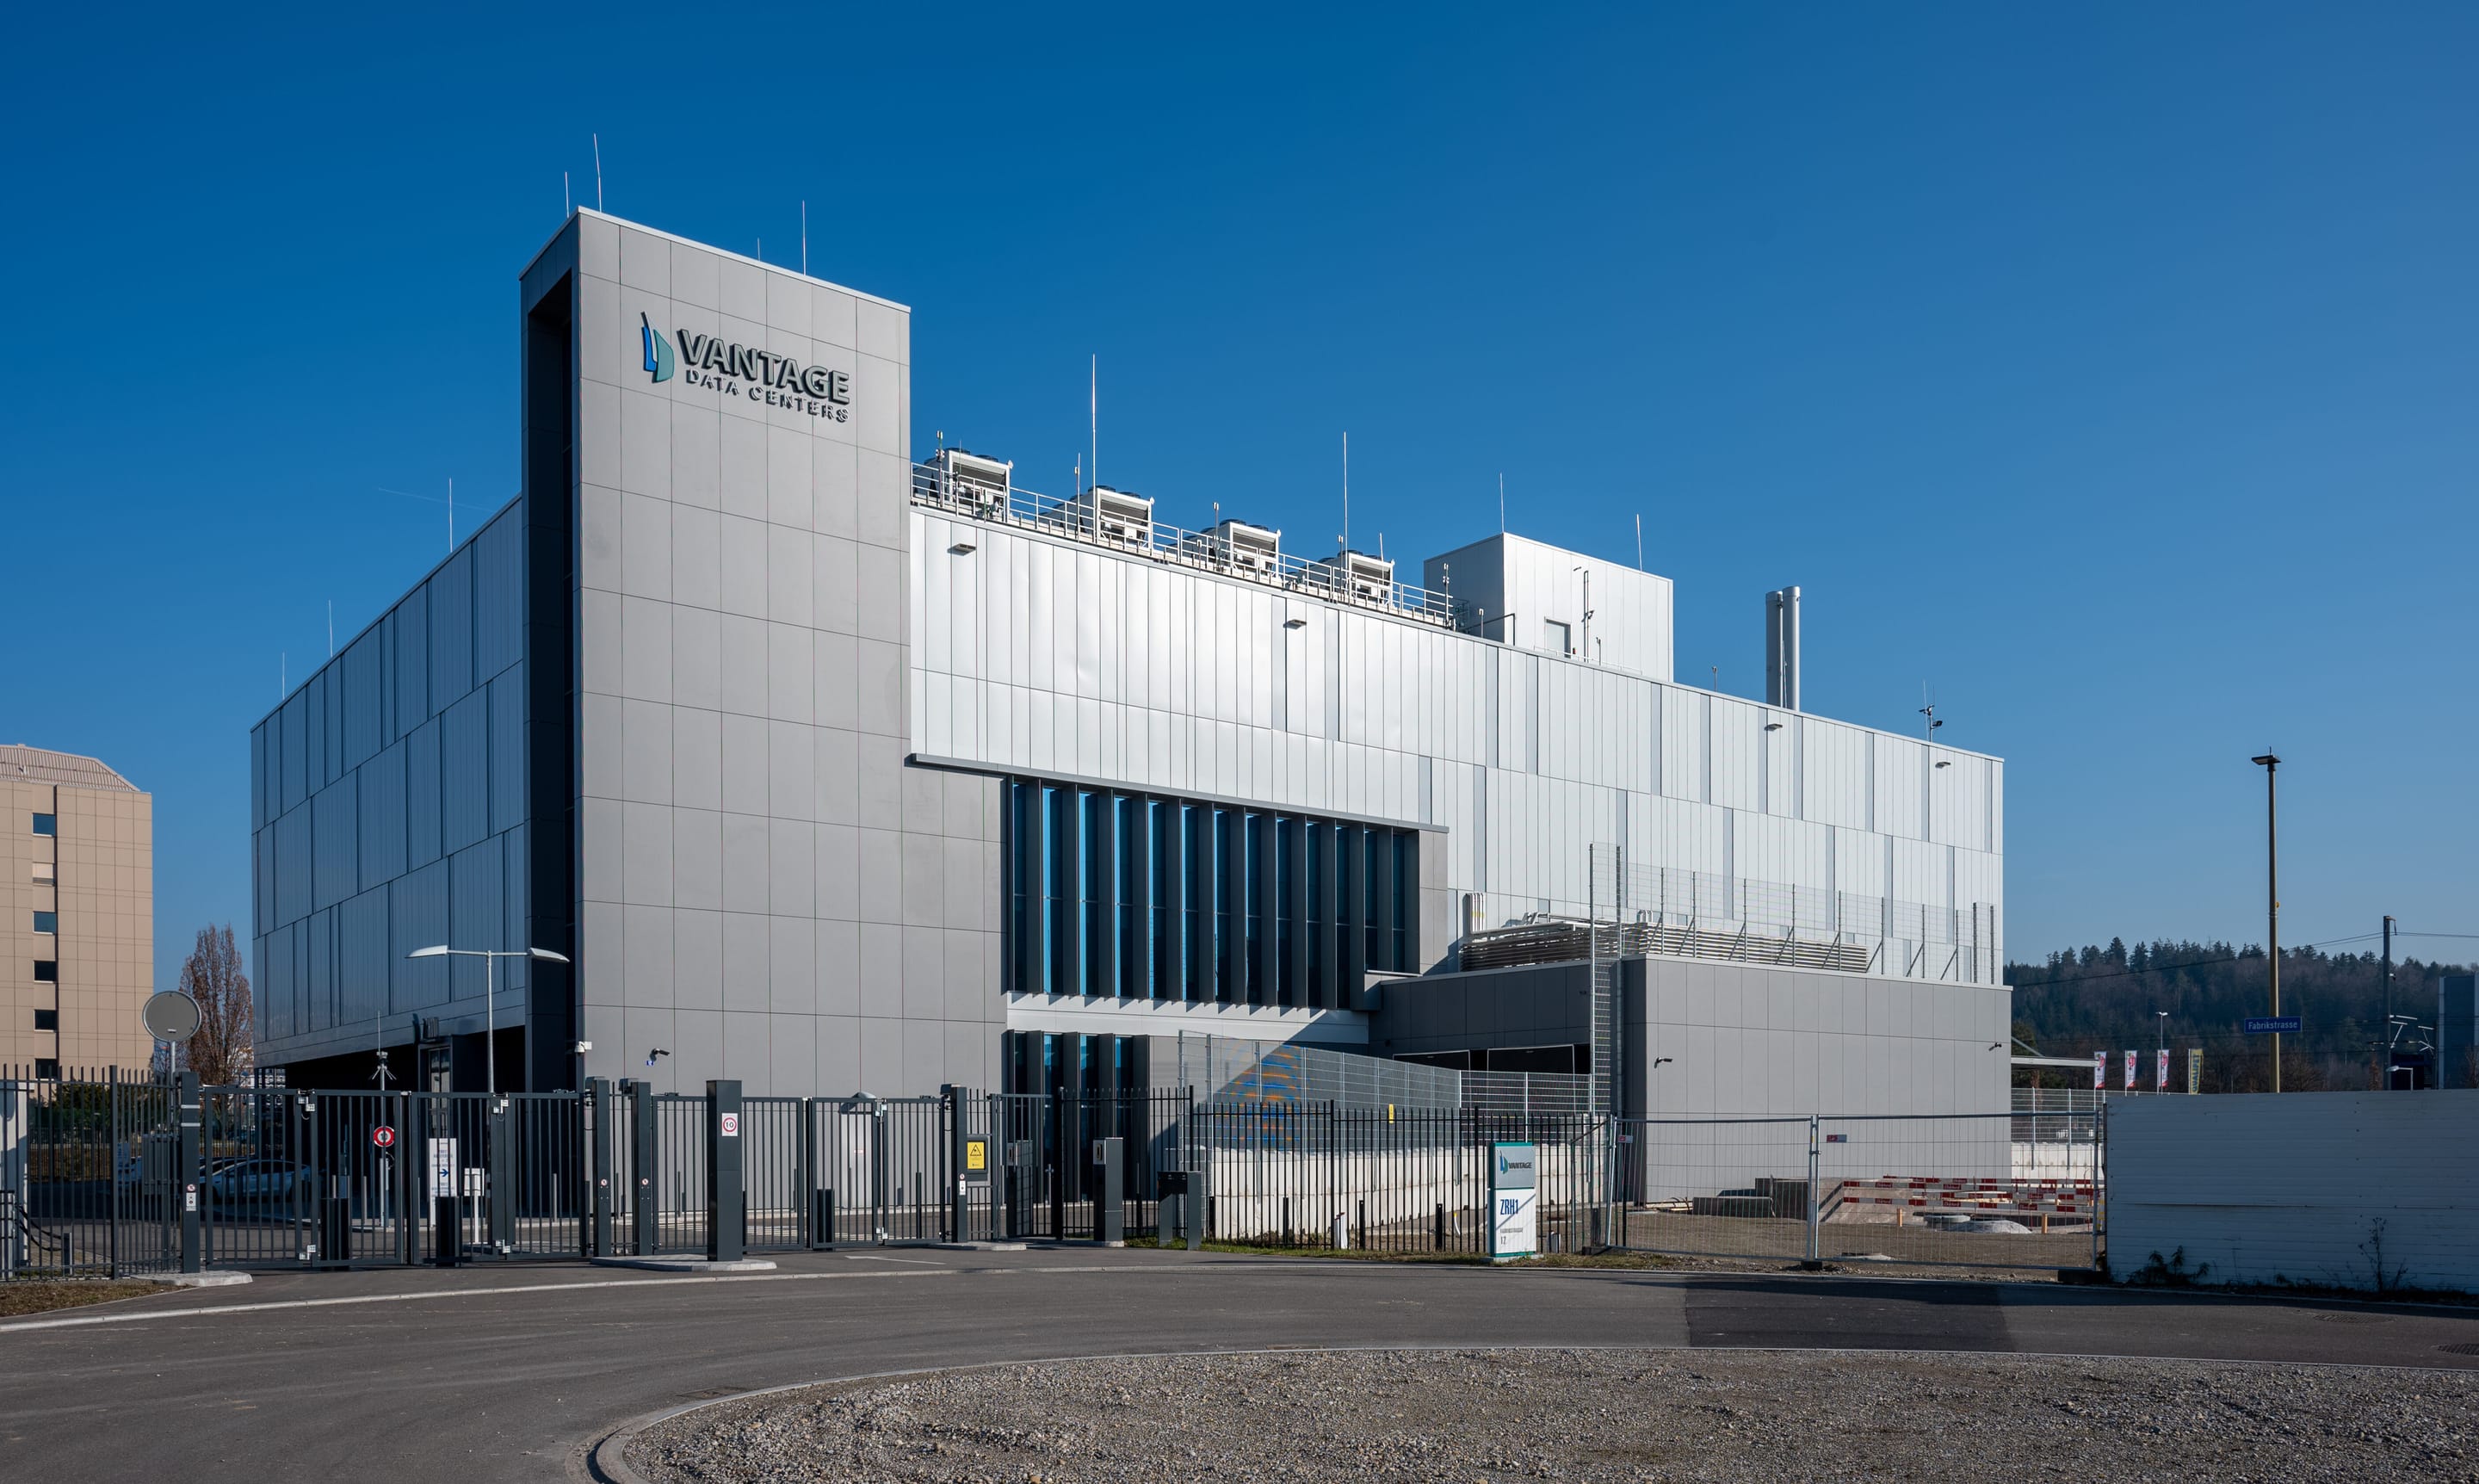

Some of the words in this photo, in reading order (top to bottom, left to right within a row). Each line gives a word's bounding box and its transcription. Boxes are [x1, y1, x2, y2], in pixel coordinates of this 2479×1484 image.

[677, 328, 850, 405] VANTAGE
[686, 368, 740, 396] DATA
[749, 386, 850, 424] CENTERS
[2247, 1021, 2298, 1030] Fabrikstrasse
[1499, 1198, 1518, 1215] ZRH1
